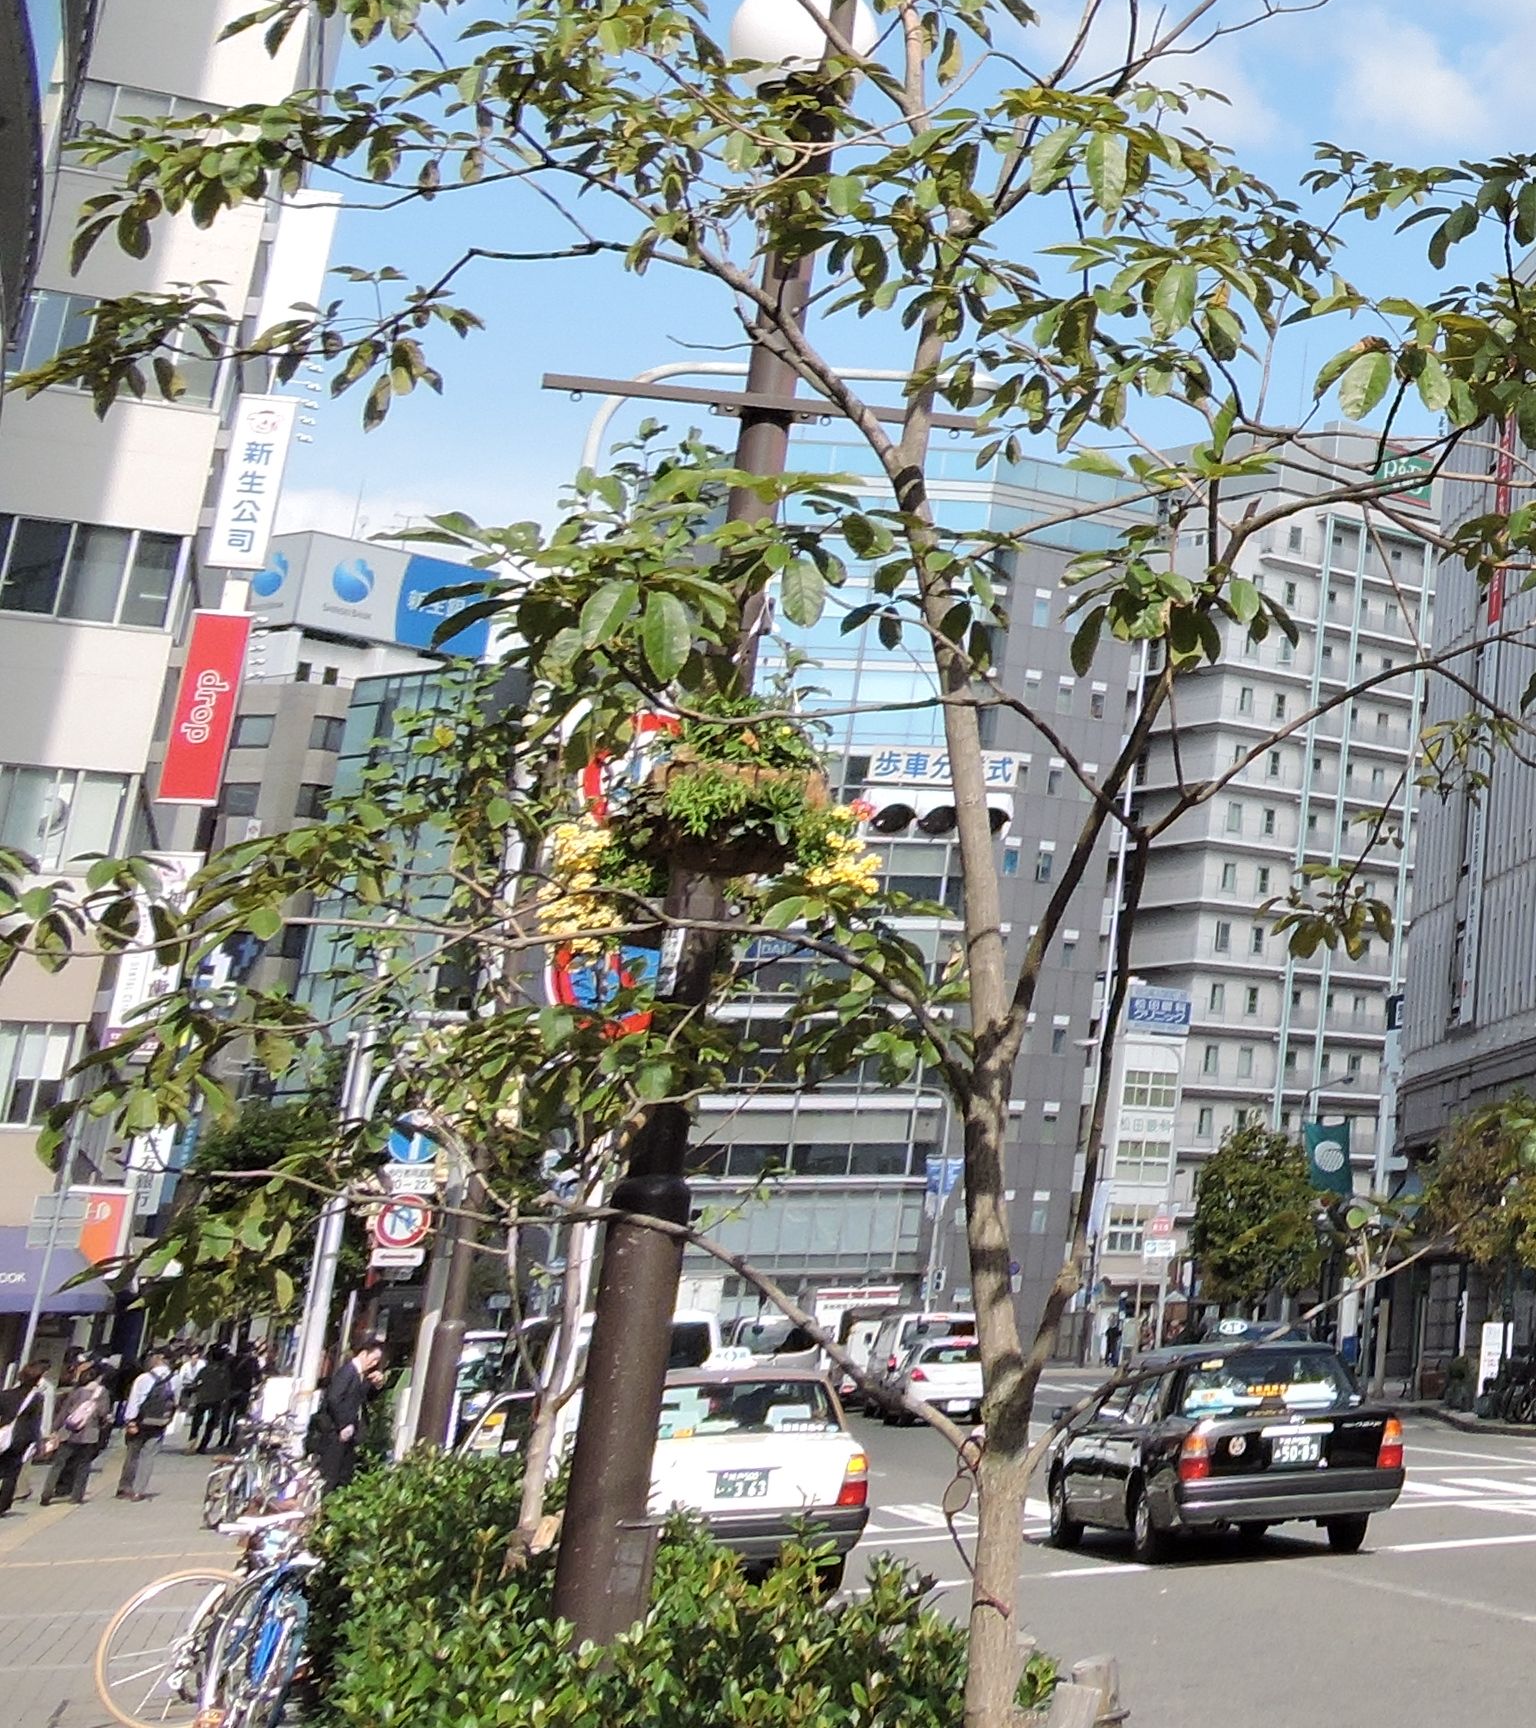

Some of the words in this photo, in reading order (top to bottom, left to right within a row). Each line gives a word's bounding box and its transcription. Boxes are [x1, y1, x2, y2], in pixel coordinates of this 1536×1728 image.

[227, 440, 274, 553] 新生公司
[181, 669, 230, 744] drop
[874, 751, 1015, 783] 歩車分式
